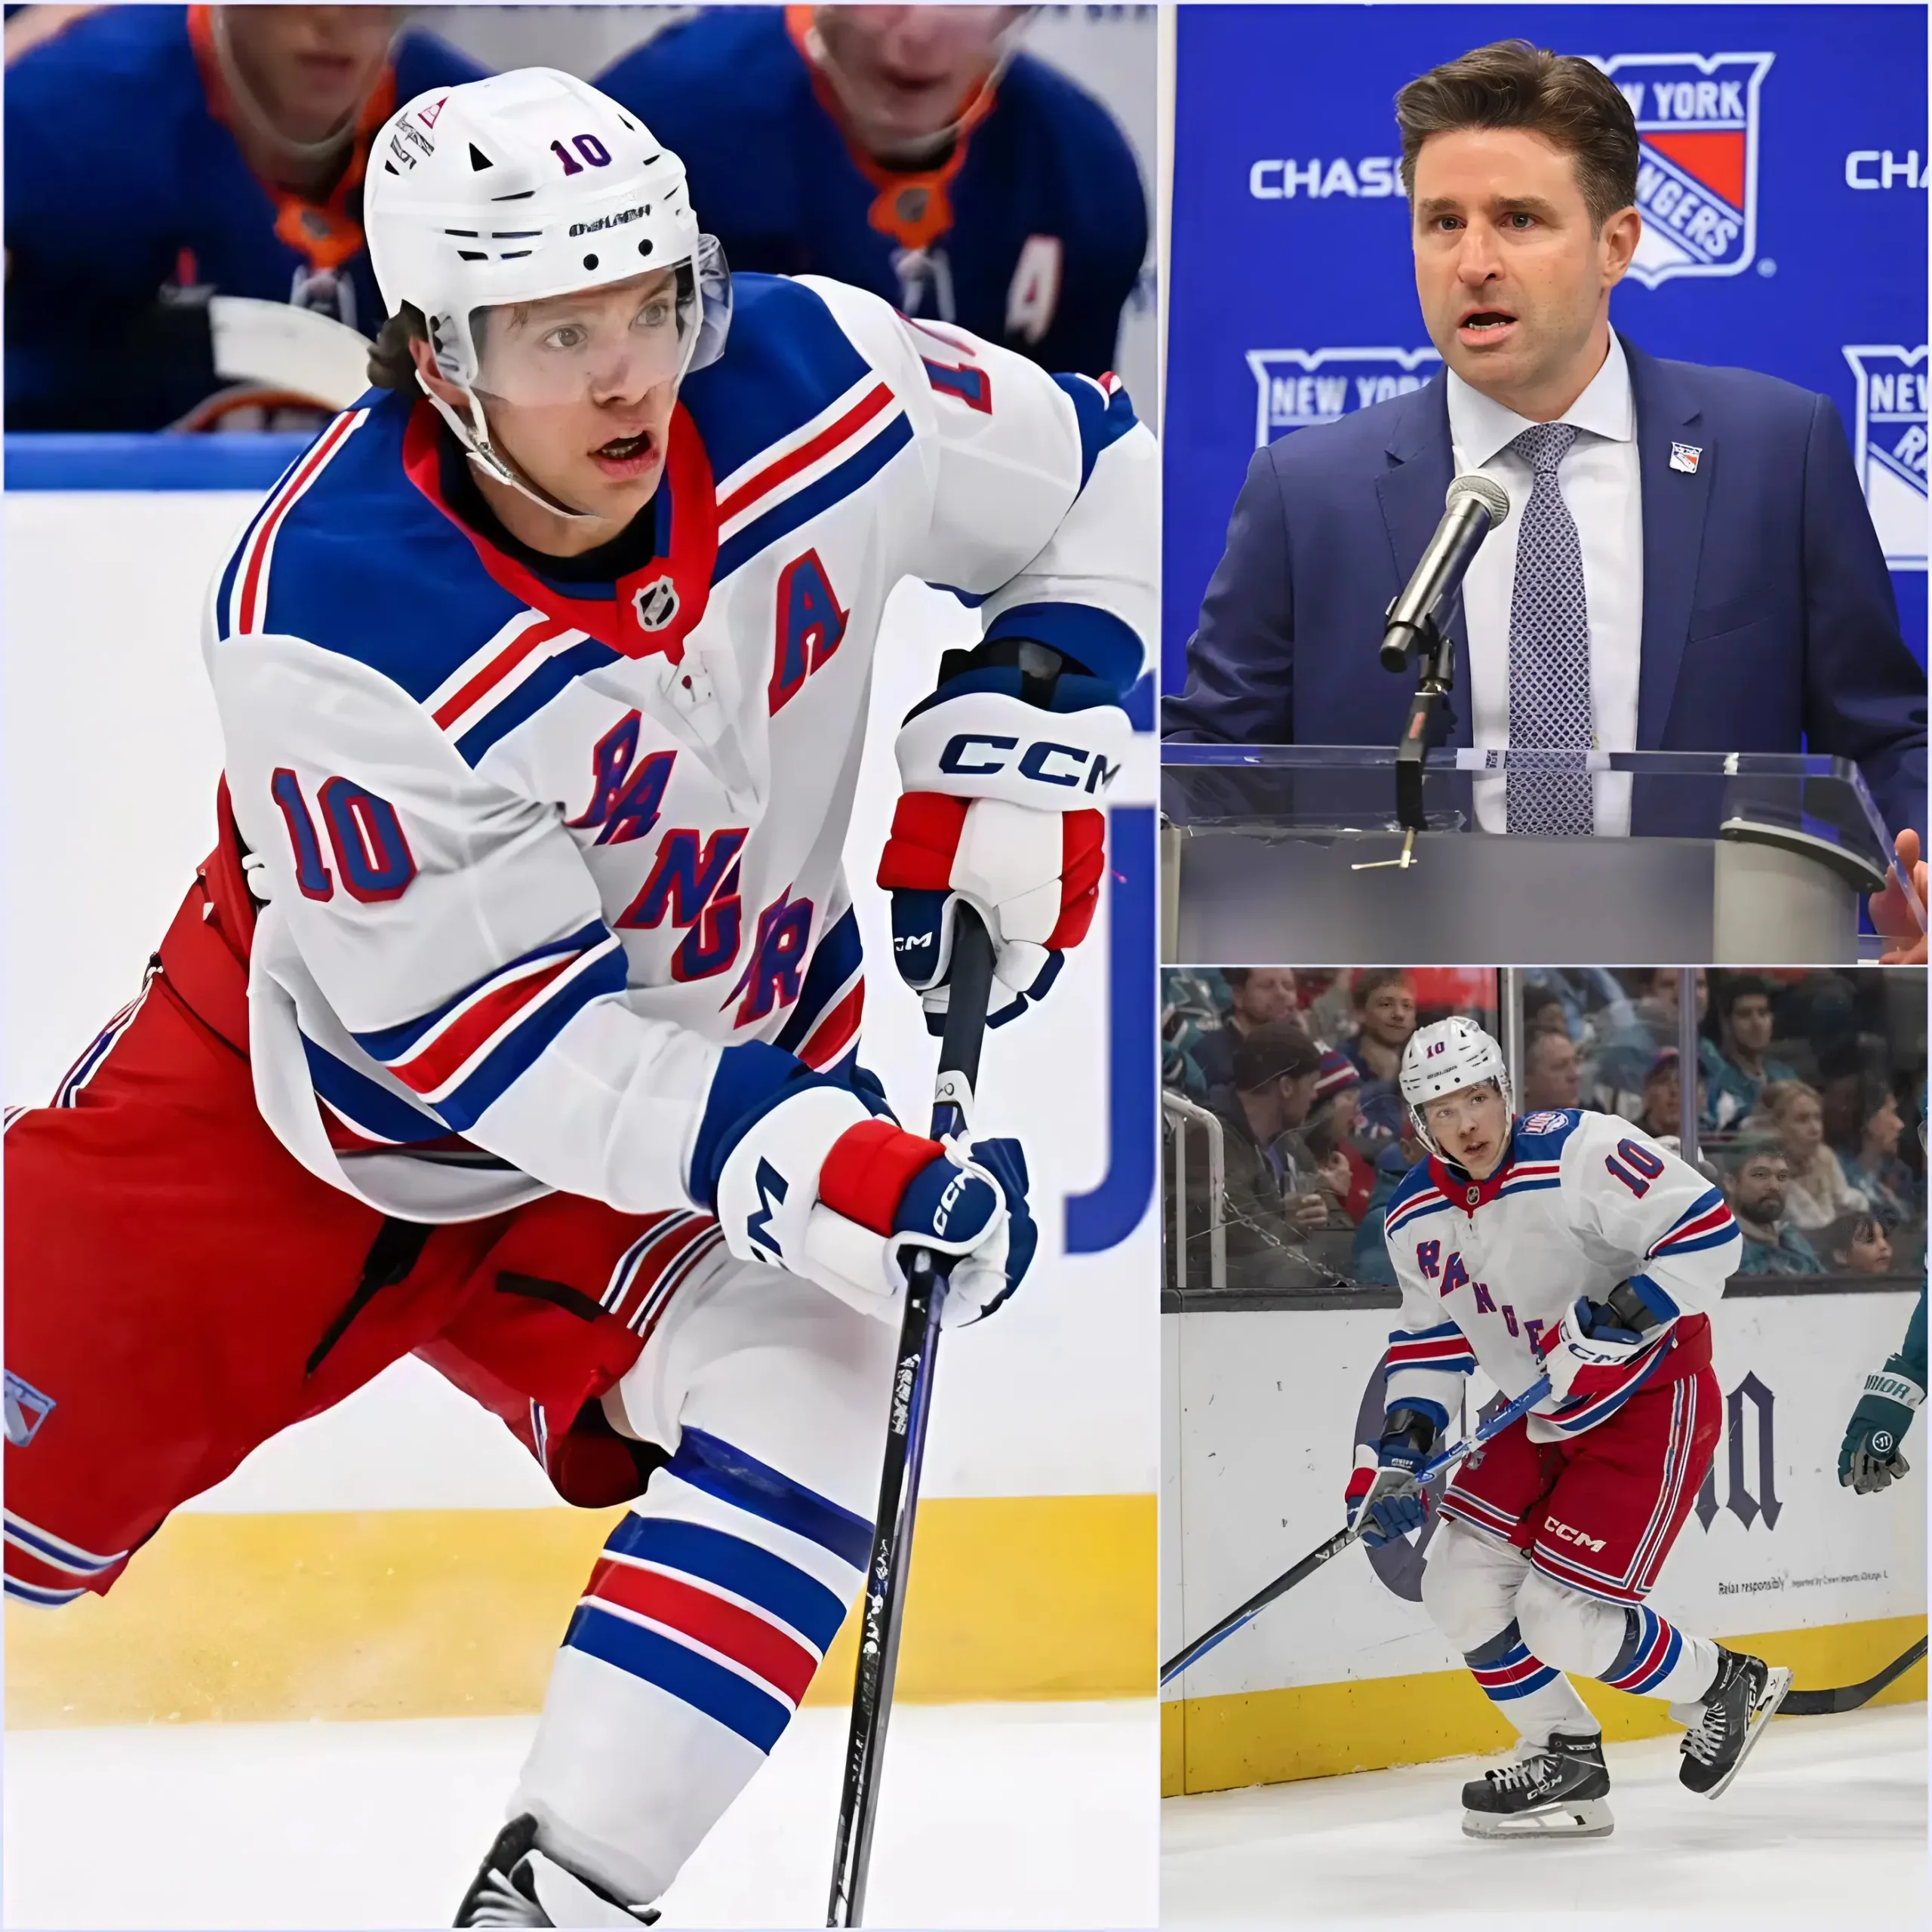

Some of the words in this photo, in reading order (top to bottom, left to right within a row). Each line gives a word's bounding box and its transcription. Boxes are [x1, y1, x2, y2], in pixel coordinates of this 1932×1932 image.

[1652, 80, 1745, 121] YORK
[549, 134, 613, 177] 10
[1635, 162, 1739, 257] NGERS
[1005, 232, 1064, 344] A
[1271, 376, 1348, 415] NEW
[768, 547, 851, 718] A
[938, 733, 1121, 794] CCM
[271, 767, 418, 903] 10
[1426, 1041, 1445, 1059] 10
[1604, 1137, 1665, 1199] 10
[1544, 1515, 1607, 1553] CCM
